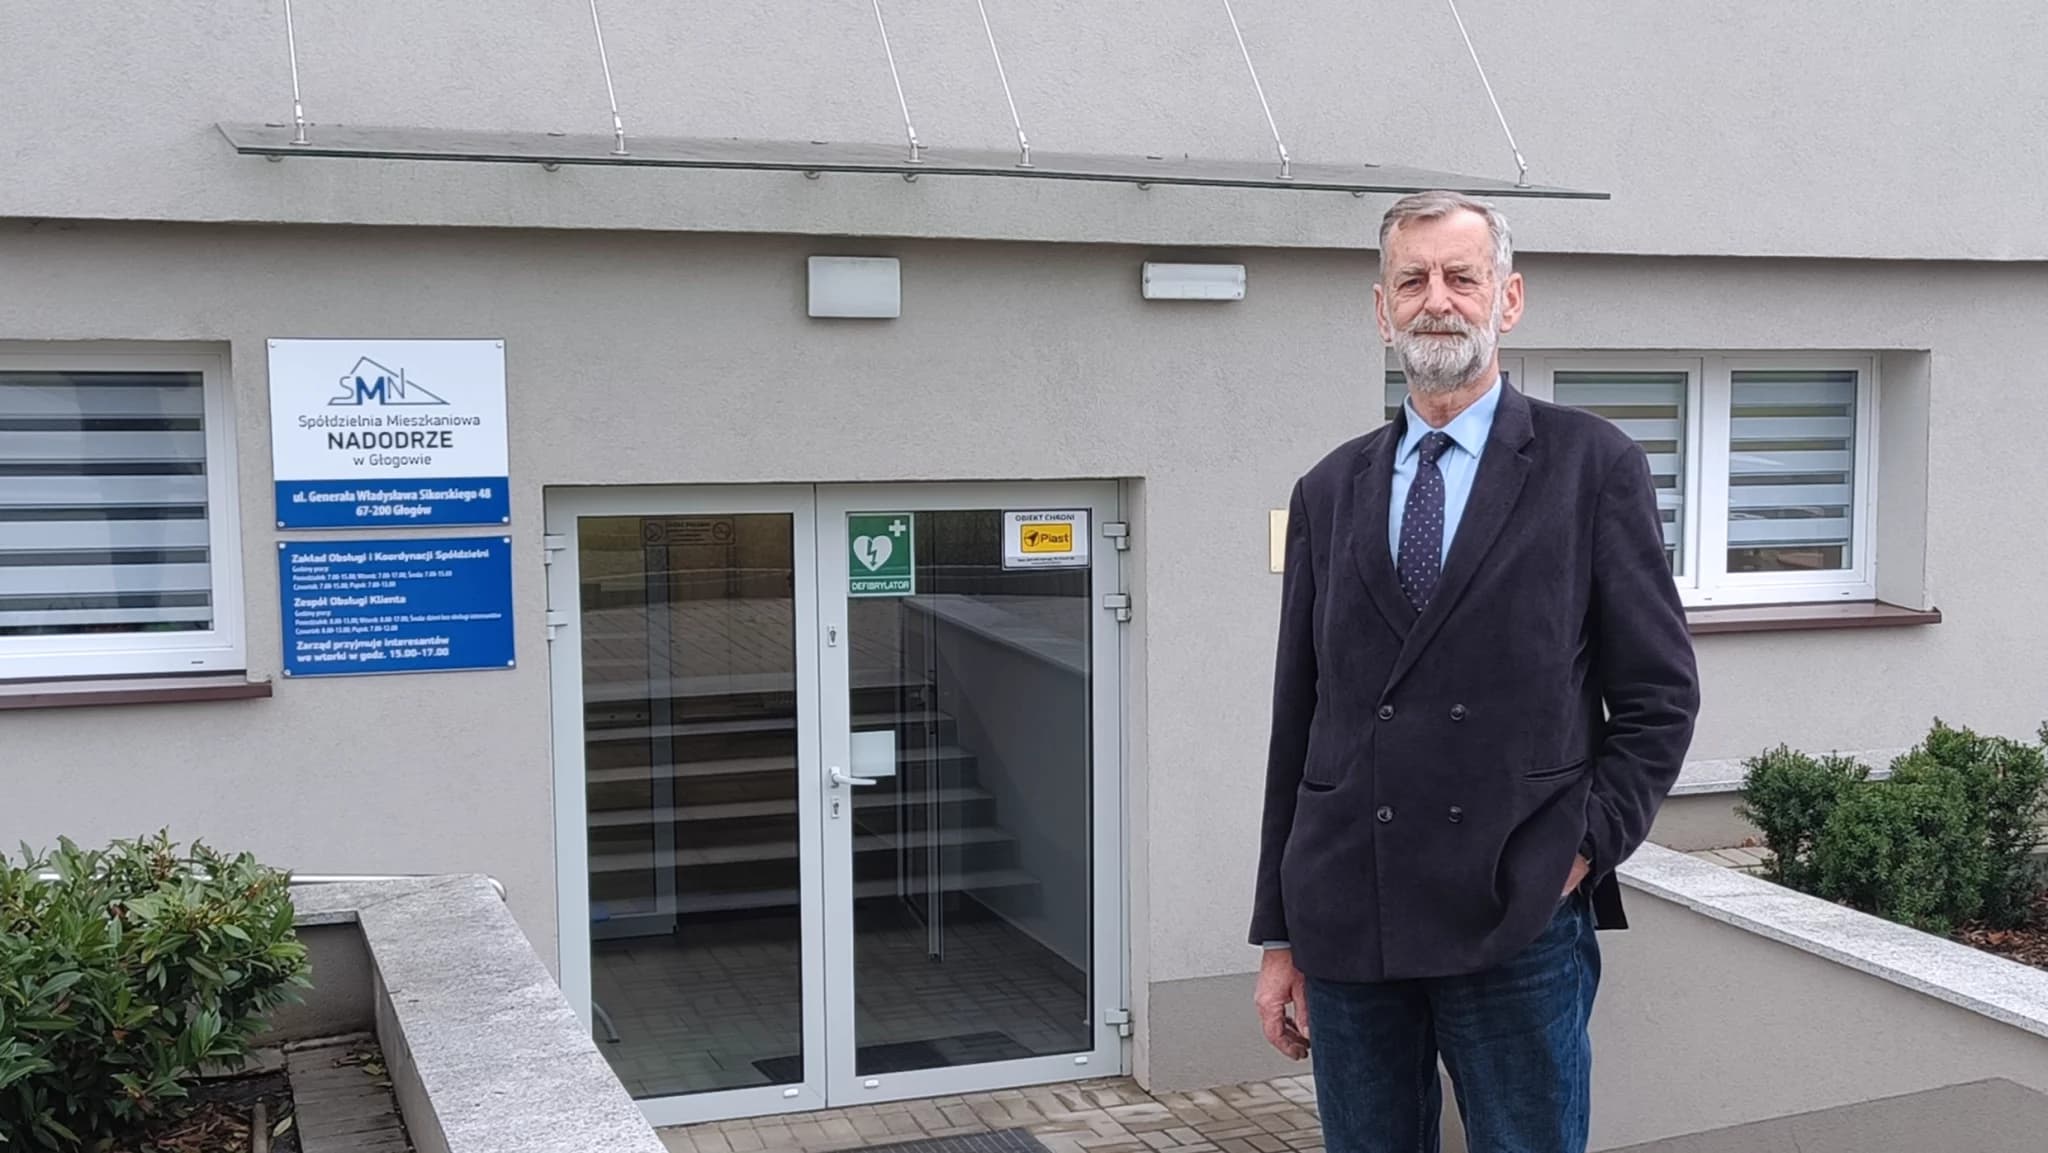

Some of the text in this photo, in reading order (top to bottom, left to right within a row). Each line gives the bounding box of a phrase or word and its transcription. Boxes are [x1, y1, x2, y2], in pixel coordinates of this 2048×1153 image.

[339, 367, 405, 405] SMN
[298, 414, 481, 429] Spółdzielnia Mieszkaniowa
[328, 431, 453, 449] NADODRZE
[353, 453, 432, 468] w Głogowie
[293, 488, 492, 504] ul. Generała Władysława Sikorskiego 48
[356, 504, 432, 517] 67-200 Głogów
[1044, 513, 1075, 521] CHRONI
[1040, 533, 1069, 543] Piast
[291, 553, 327, 563] Zakład
[328, 552, 367, 564] Obsługi
[374, 551, 433, 562] Koordynacji
[435, 549, 489, 561] Spółdzielni
[851, 580, 910, 591] DEFIBRYLATOR
[293, 595, 407, 608] Zespół Obsługi Klienta
[296, 636, 449, 651] Zarząd przyjmuje interesantów
[297, 654, 312, 662] we
[314, 652, 347, 661] wtorki
[359, 650, 387, 662] godz.
[390, 647, 449, 658] 15.00-17.00
